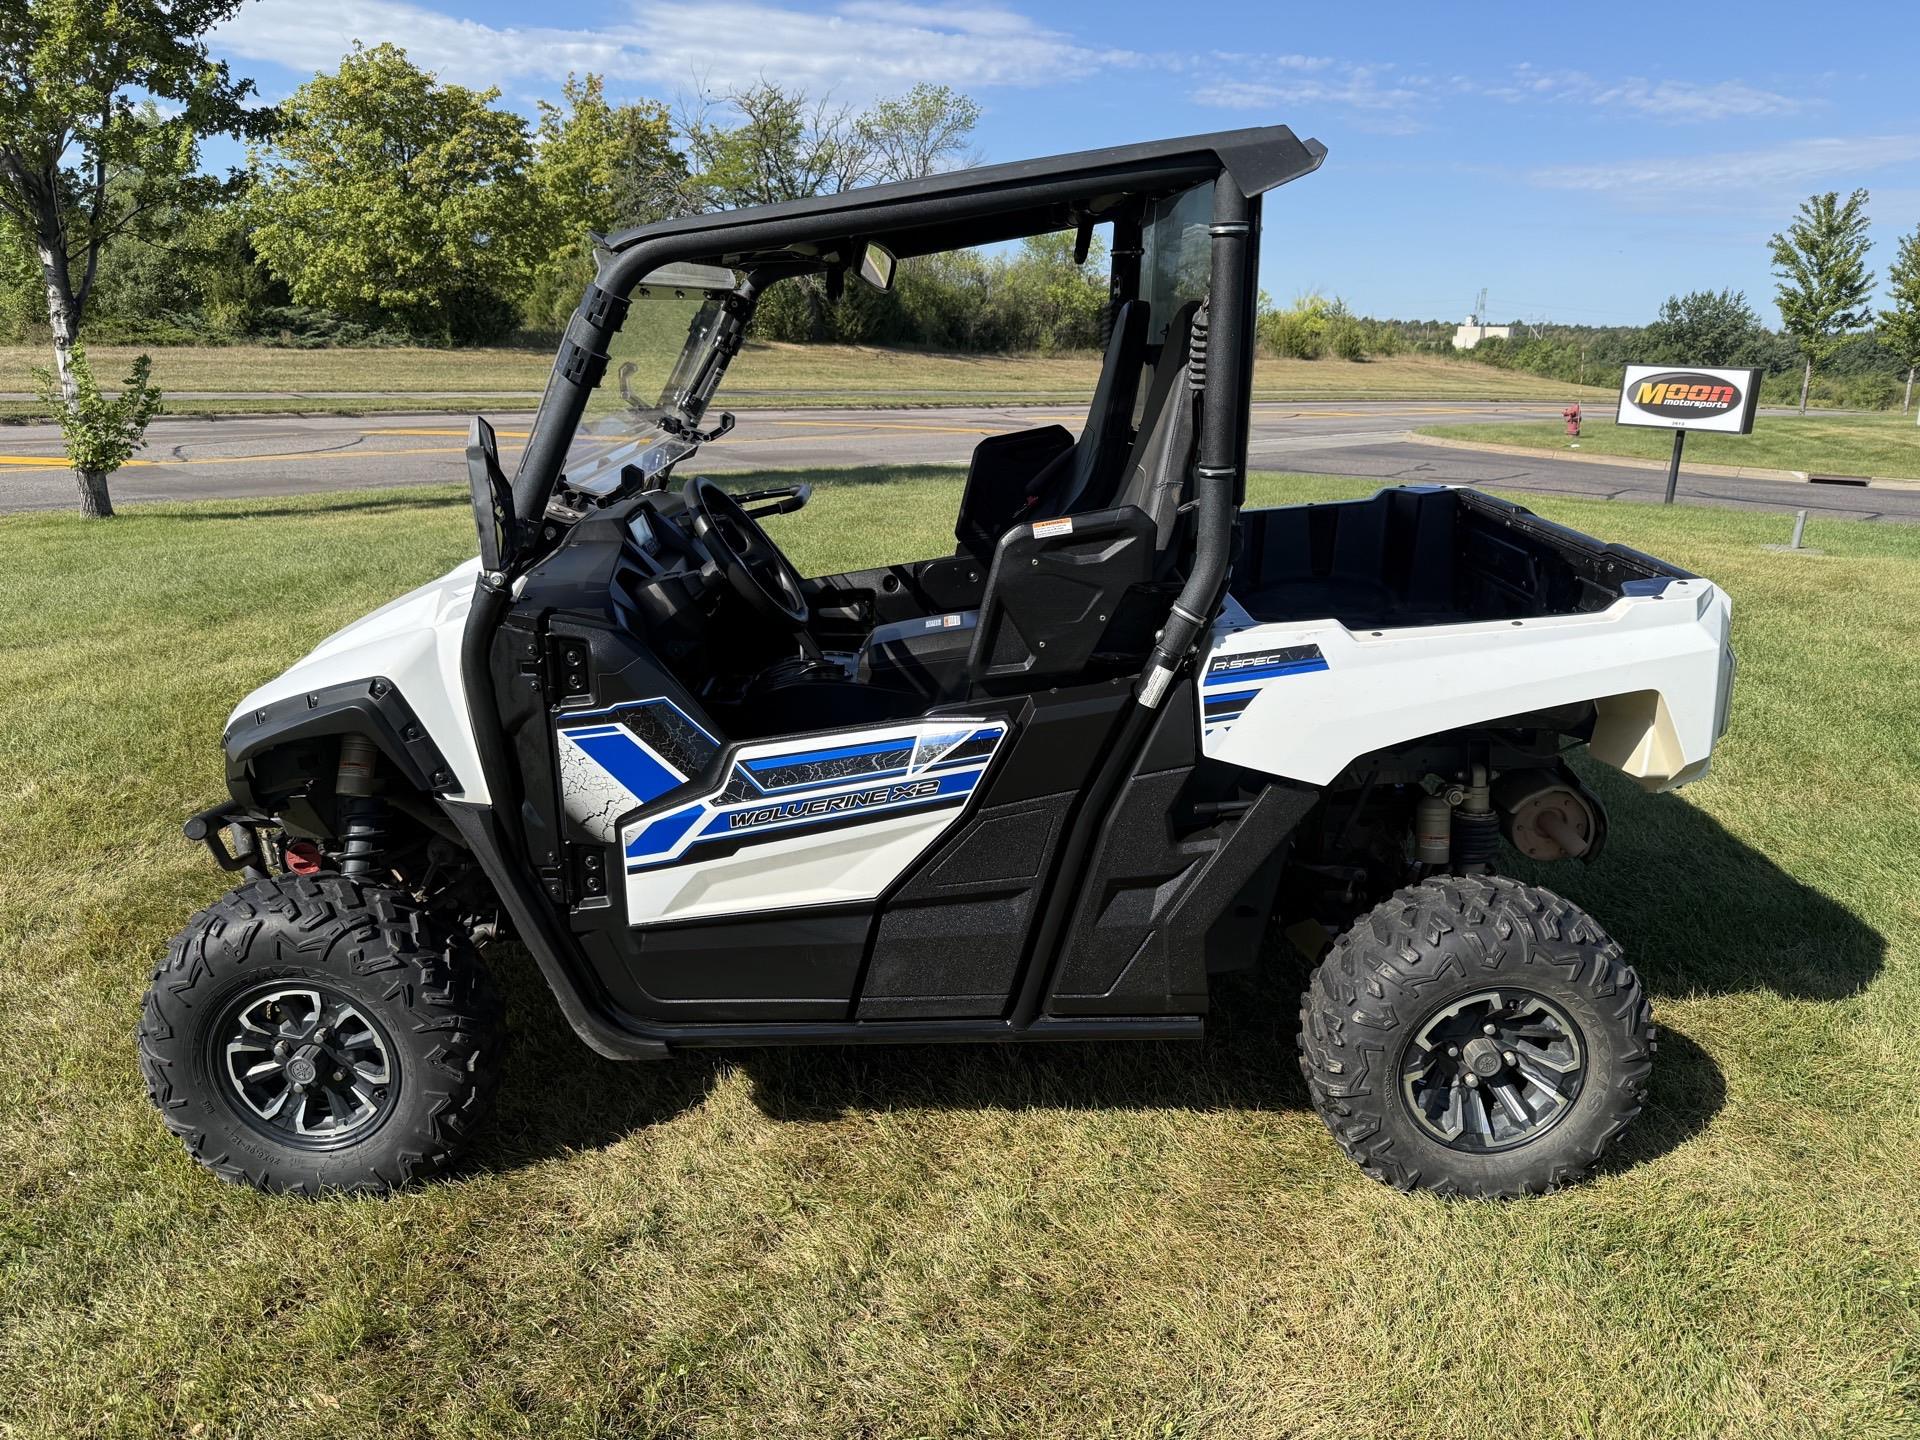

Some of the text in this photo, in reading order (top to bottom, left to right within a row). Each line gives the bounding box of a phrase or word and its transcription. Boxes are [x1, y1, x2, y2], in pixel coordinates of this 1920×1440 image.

[1663, 399, 1728, 408] motorsports
[729, 780, 940, 829] WOLVERINE X2
